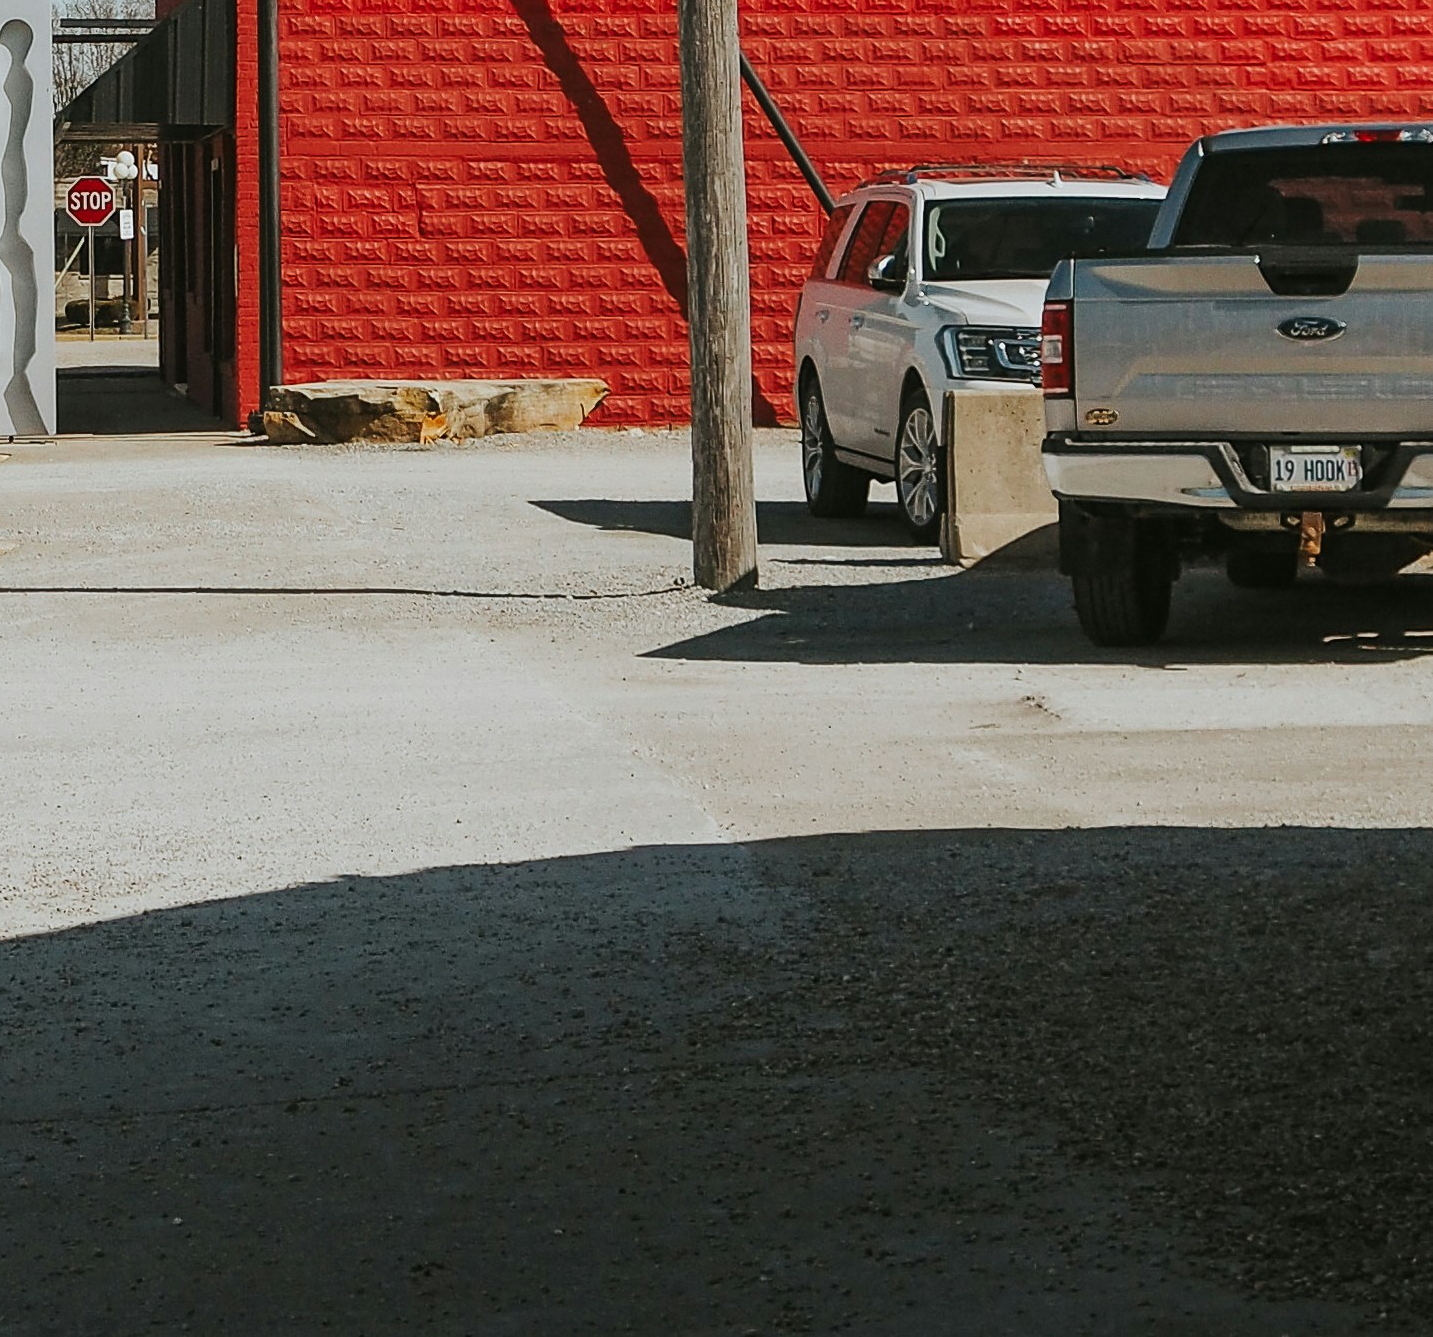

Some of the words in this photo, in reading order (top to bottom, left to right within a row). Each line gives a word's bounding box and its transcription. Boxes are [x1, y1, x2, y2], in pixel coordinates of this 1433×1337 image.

[70, 191, 112, 211] STOP
[1290, 321, 1329, 337] Ford
[1274, 459, 1296, 482] 19
[1304, 459, 1346, 482] HOOK
